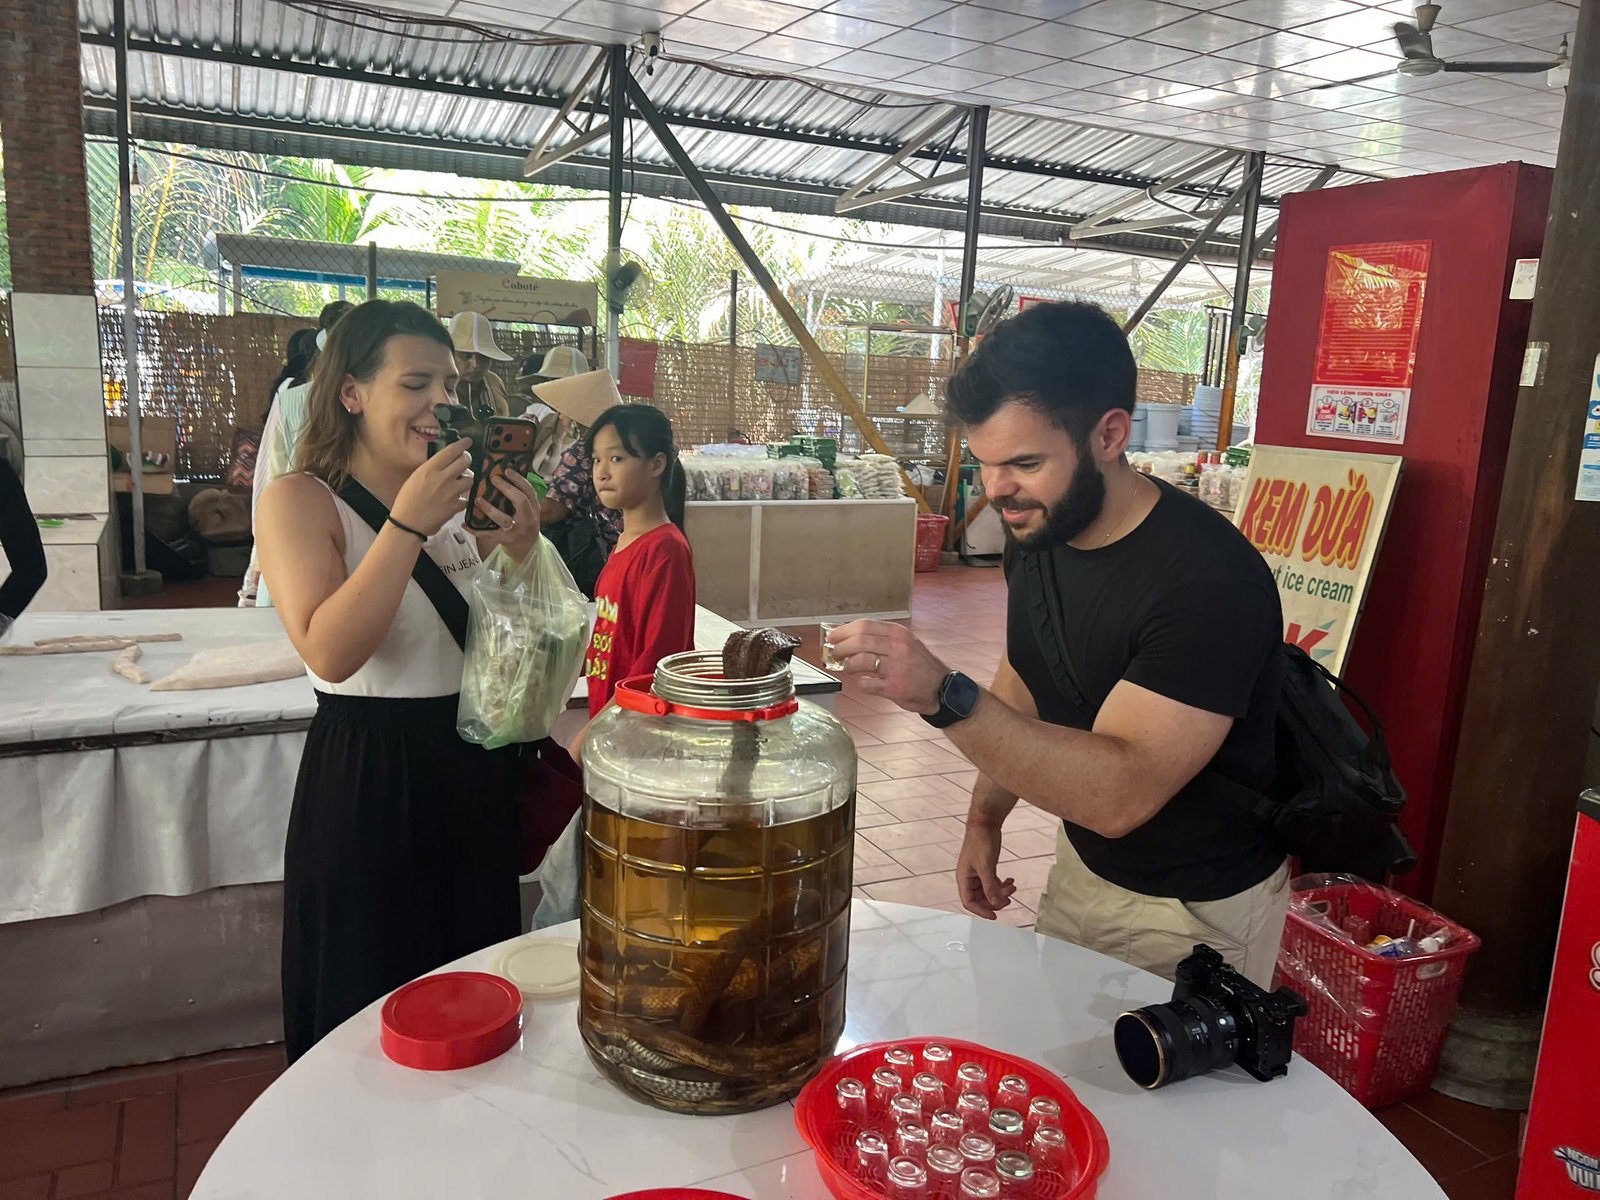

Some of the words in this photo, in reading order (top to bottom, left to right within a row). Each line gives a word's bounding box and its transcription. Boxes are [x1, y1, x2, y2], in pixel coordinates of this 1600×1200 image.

[1239, 477, 1310, 558] KEM
[1282, 565, 1304, 592] ice
[1306, 575, 1354, 604] cream
